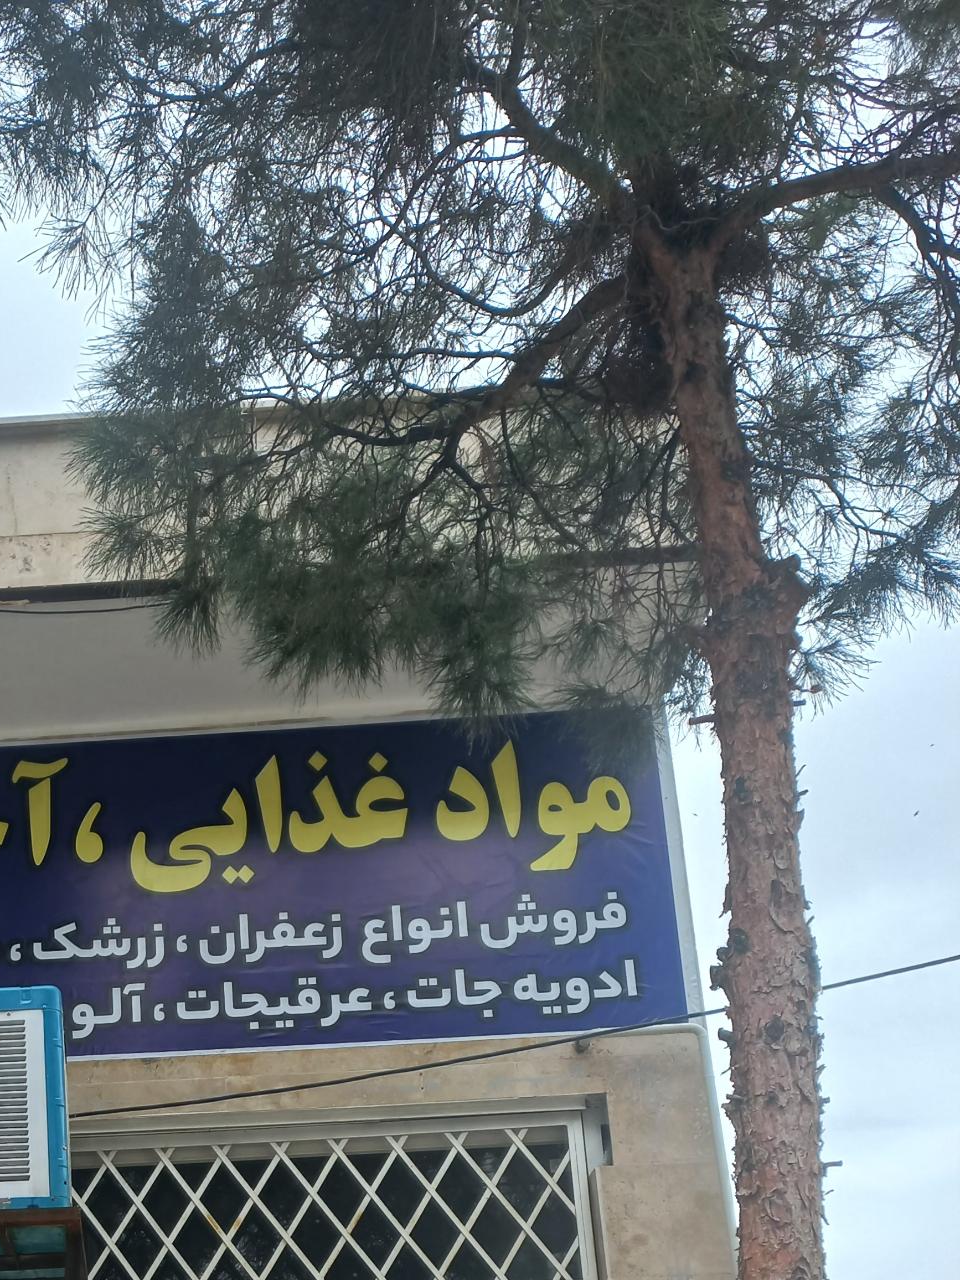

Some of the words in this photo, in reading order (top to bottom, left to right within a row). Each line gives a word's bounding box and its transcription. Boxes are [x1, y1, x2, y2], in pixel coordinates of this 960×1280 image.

[435, 740, 632, 872] مواد
[362, 904, 468, 964] انواع
[480, 890, 628, 949] فروش
[514, 959, 638, 1016] ادویه
